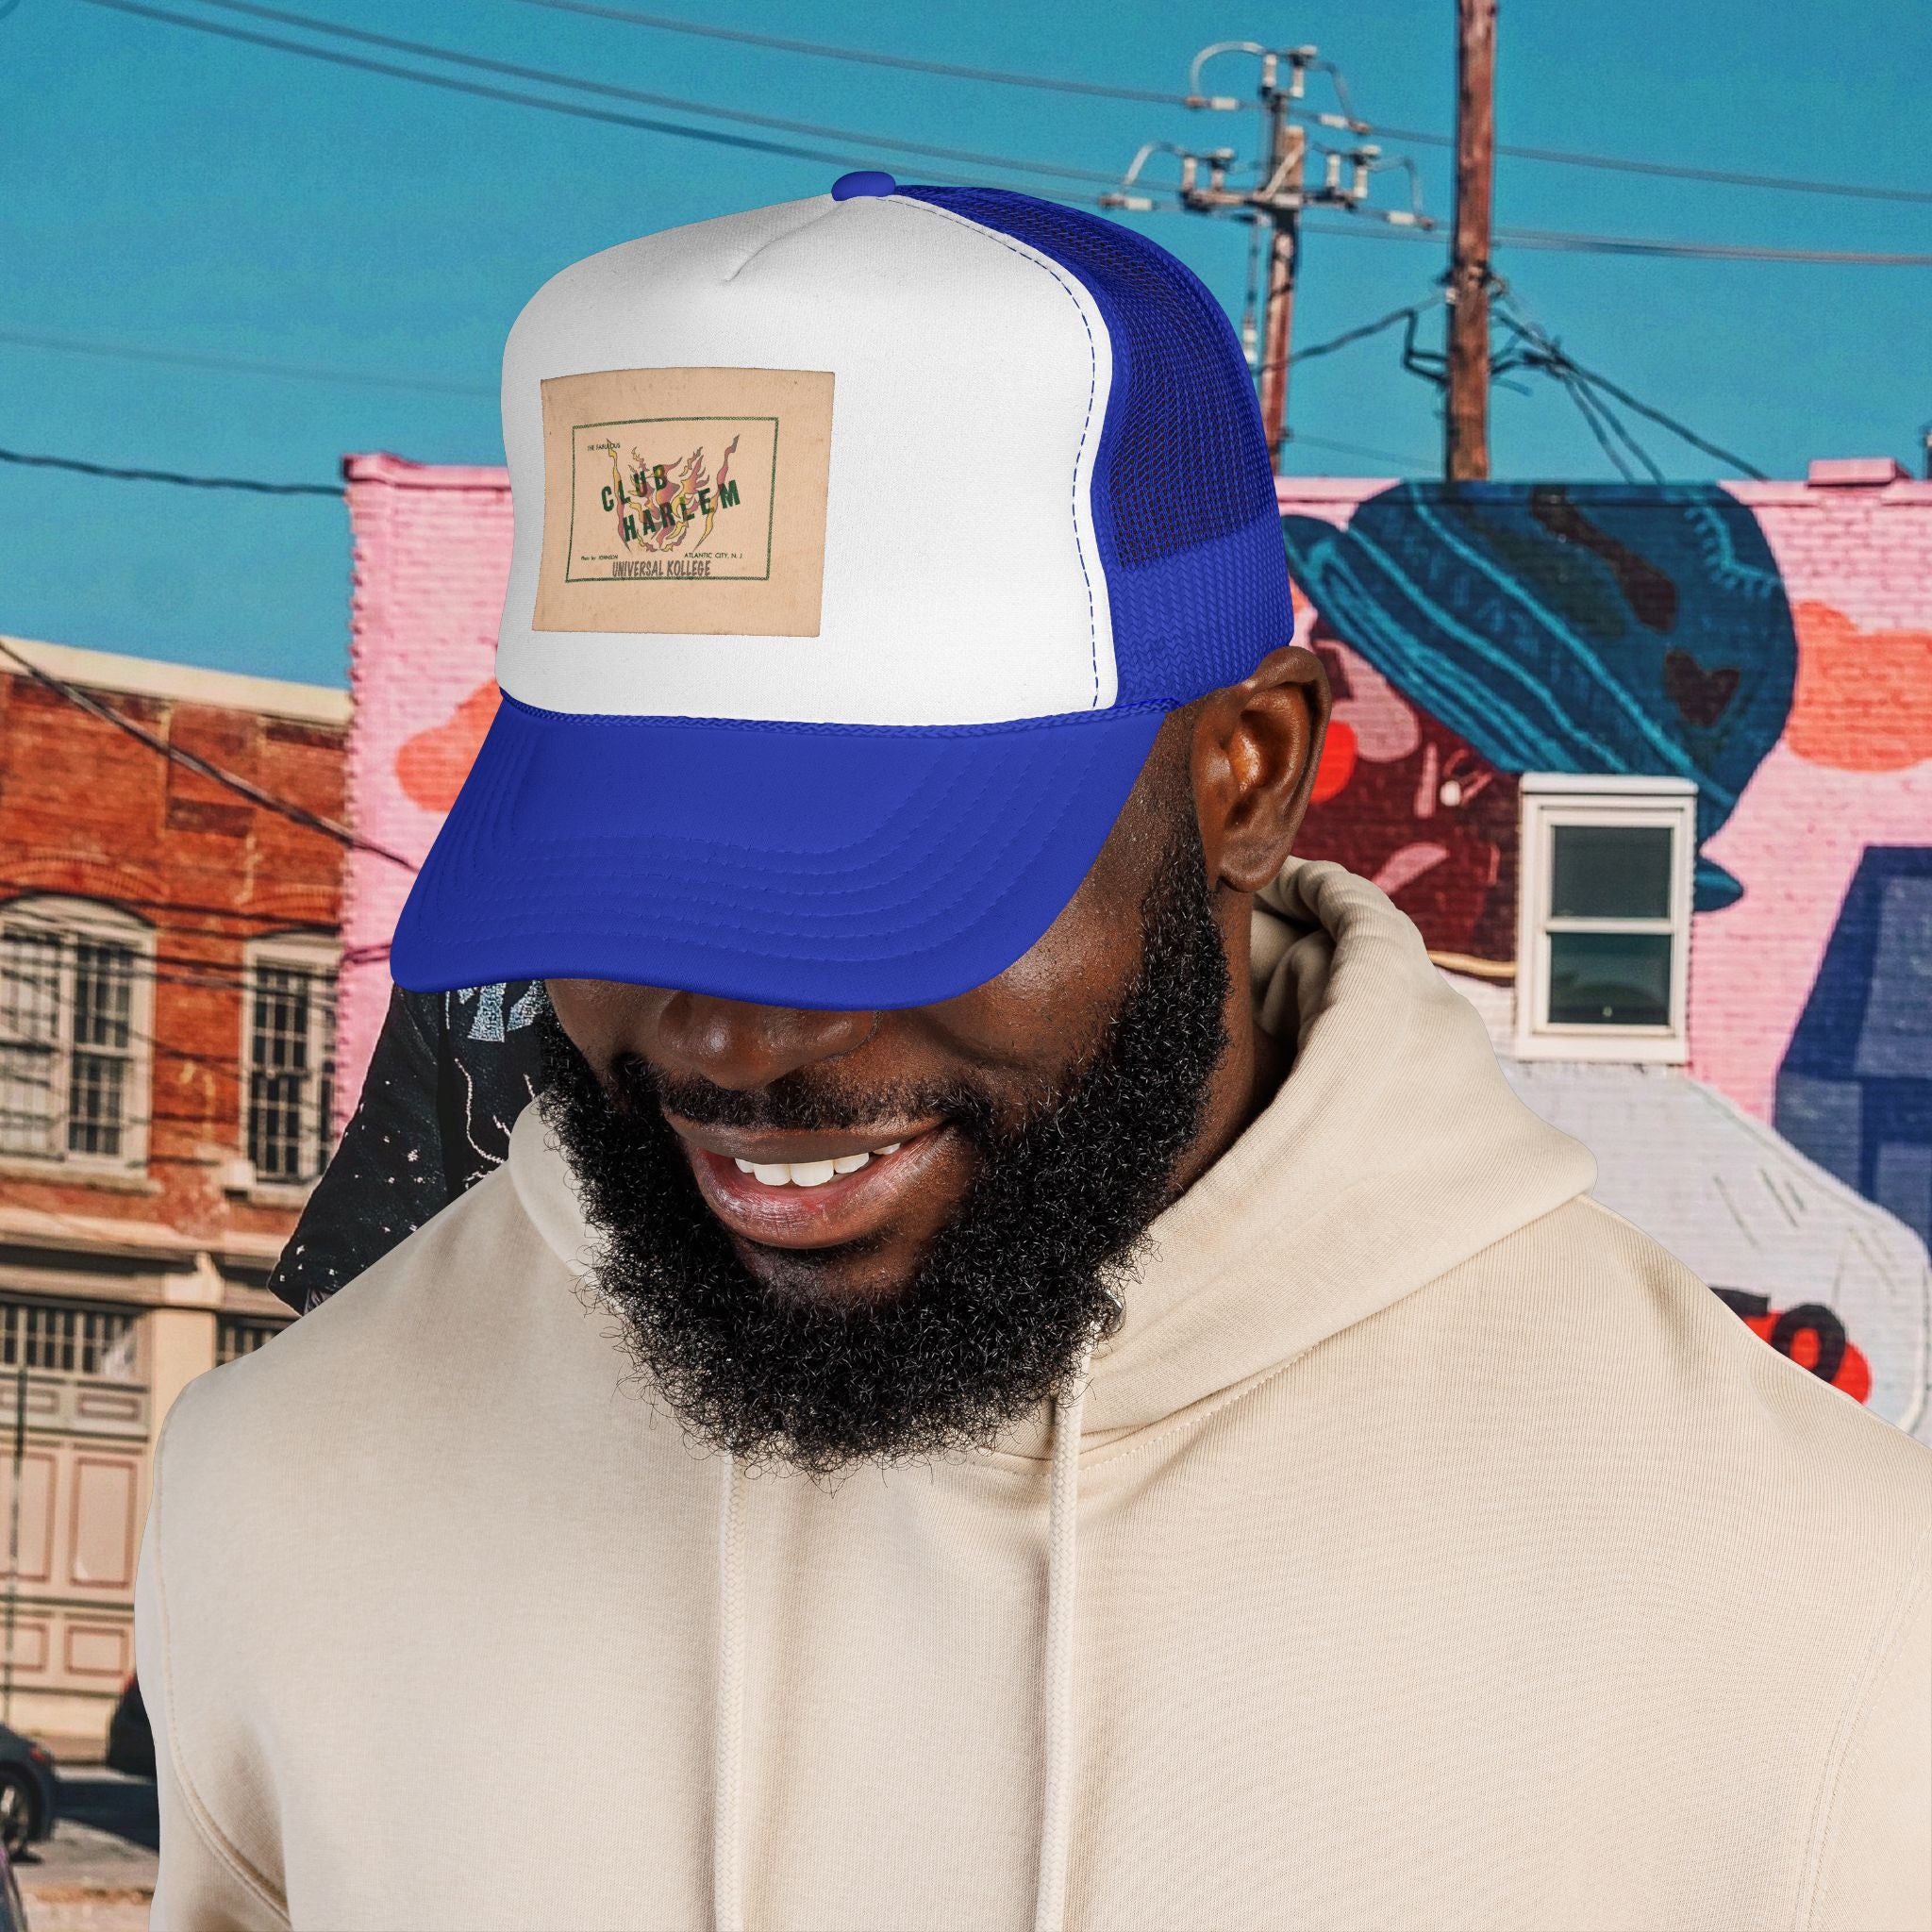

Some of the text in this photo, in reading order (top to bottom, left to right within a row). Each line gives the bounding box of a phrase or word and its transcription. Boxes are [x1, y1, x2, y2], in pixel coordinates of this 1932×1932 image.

[601, 464, 667, 511] CLUB
[623, 479, 741, 541] HARLEM
[612, 559, 710, 577] UNIVERSAL KOLLEGE
